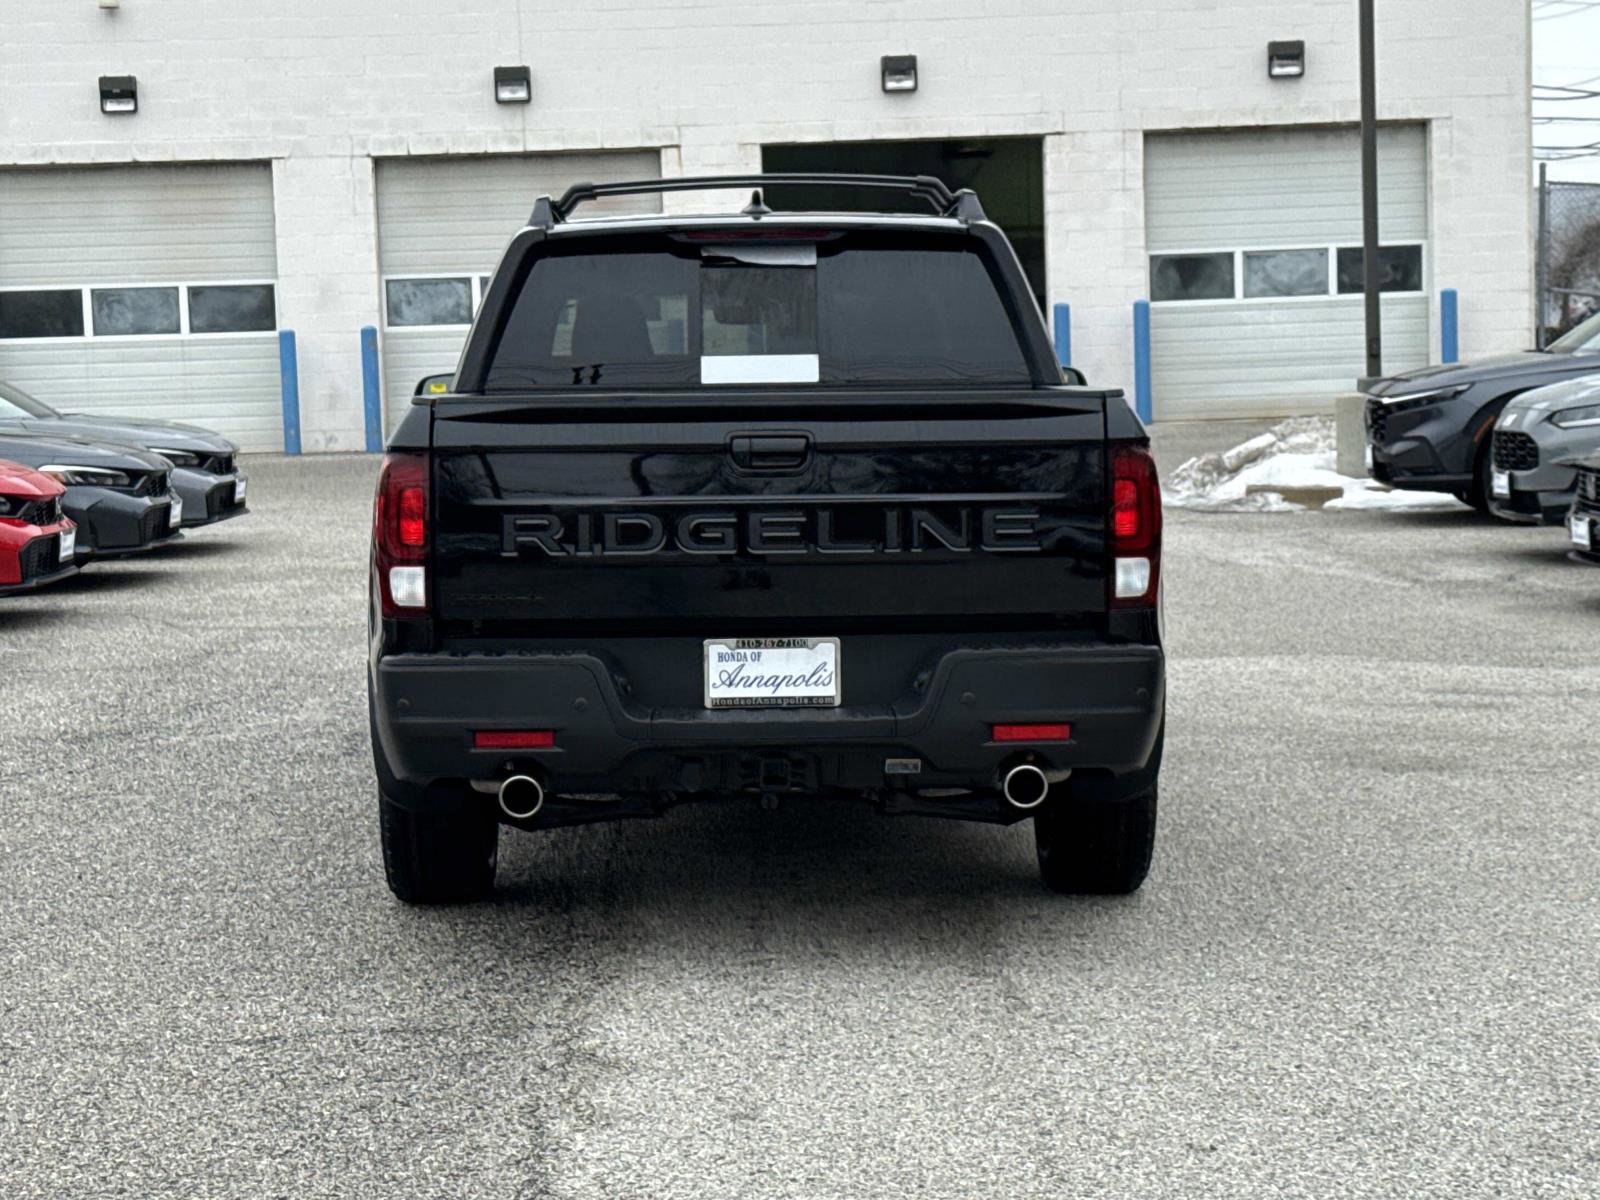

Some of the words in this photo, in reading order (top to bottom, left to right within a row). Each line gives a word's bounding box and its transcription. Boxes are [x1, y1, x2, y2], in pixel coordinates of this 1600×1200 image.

[501, 509, 1041, 556] RIDGELINE
[717, 652, 748, 662] HONDA
[750, 652, 762, 662] OF
[711, 661, 834, 694] Annapolis
[712, 696, 834, 706] HondaofAnnapolis.com
